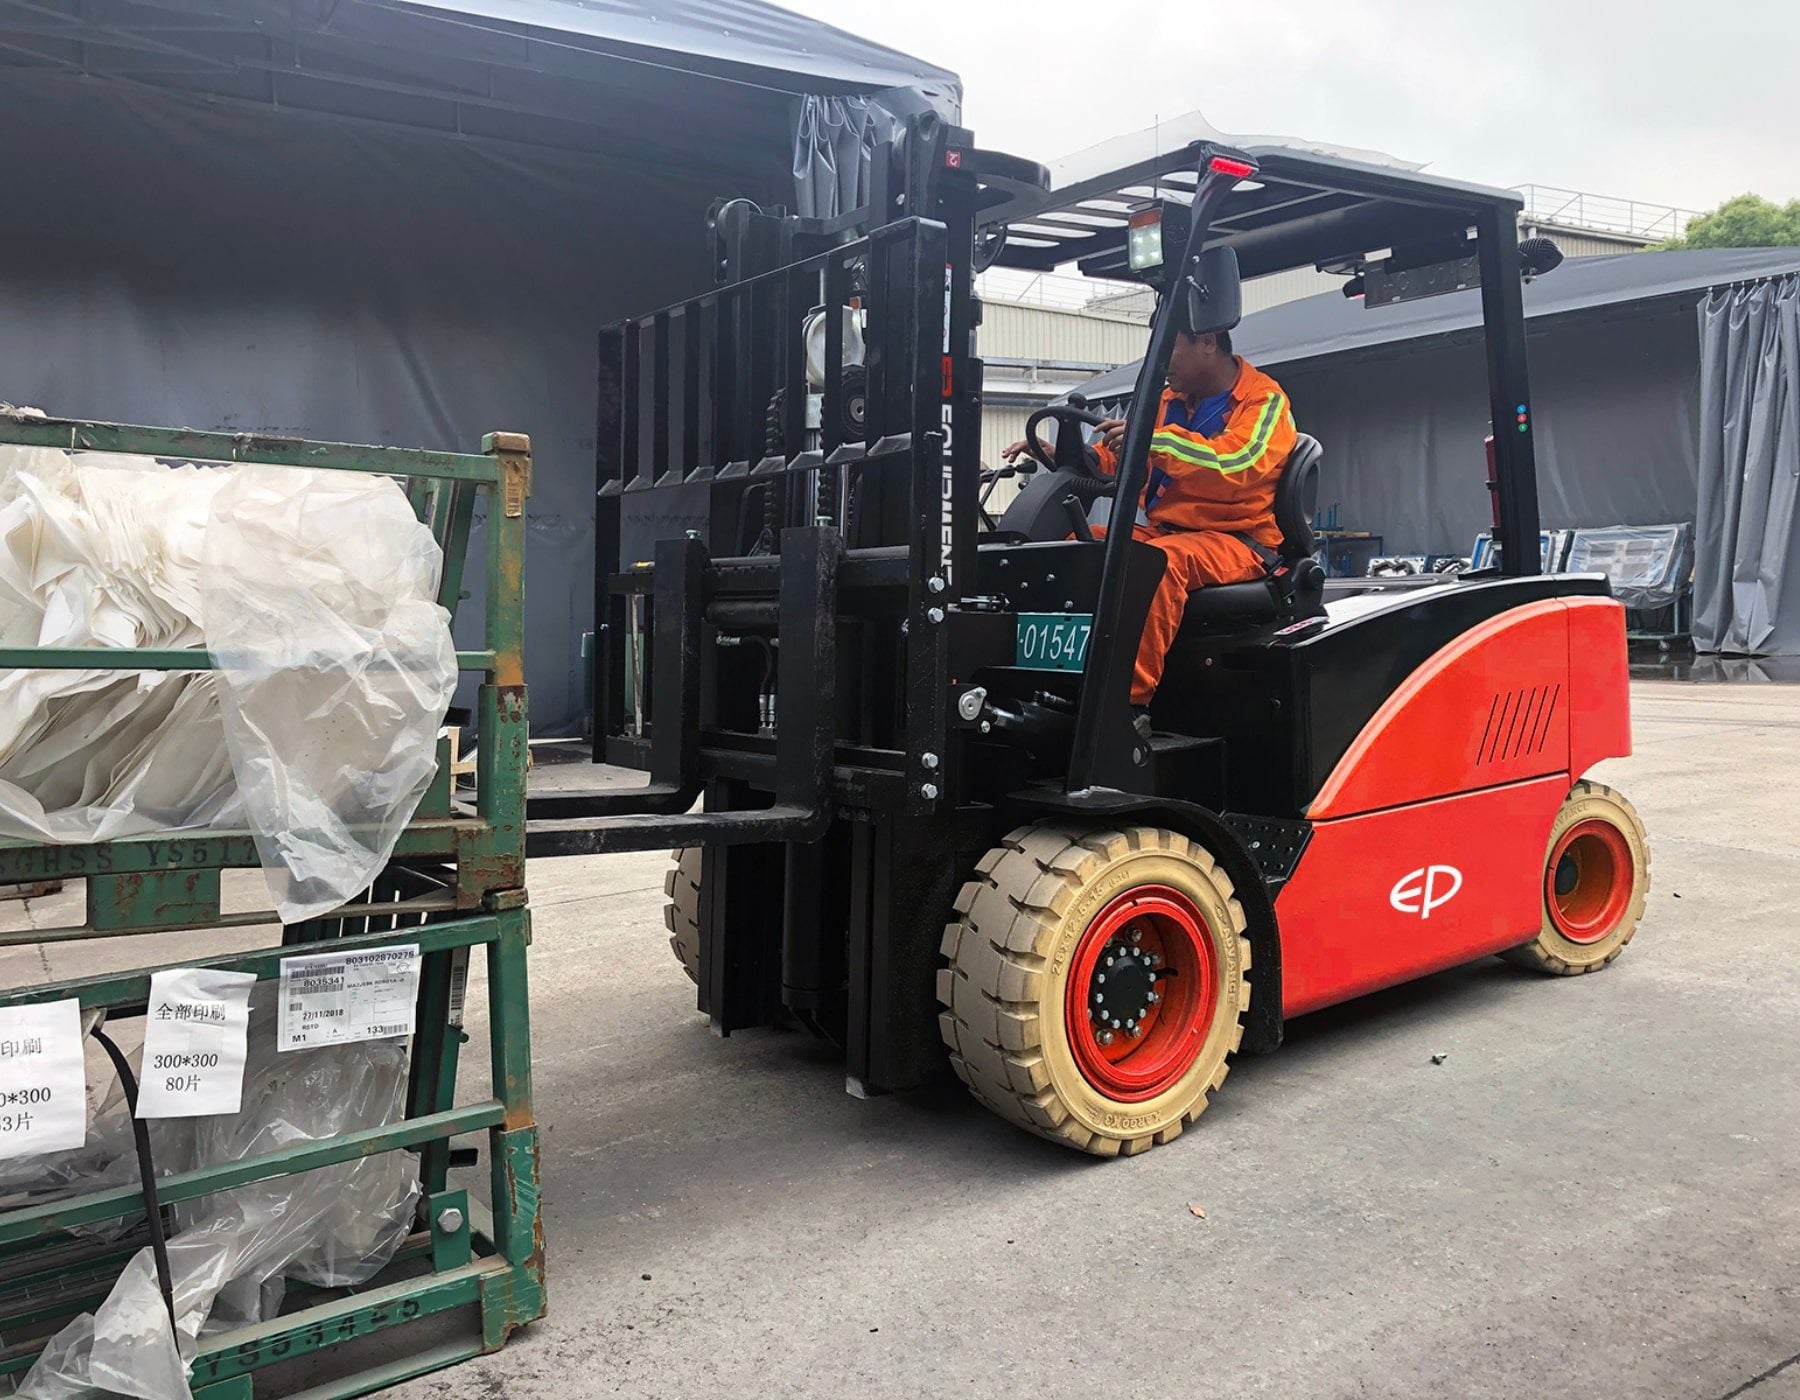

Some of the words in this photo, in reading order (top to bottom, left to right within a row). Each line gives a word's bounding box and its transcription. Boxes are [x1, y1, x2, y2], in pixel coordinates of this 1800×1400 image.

[1389, 864, 1463, 920] EP
[155, 1002, 226, 1022] 全部印刷
[291, 1034, 307, 1043] M1
[366, 1025, 384, 1035] 133
[1, 1037, 42, 1057] 印刷
[165, 1075, 201, 1092] 80片
[0, 1111, 33, 1132] 3片
